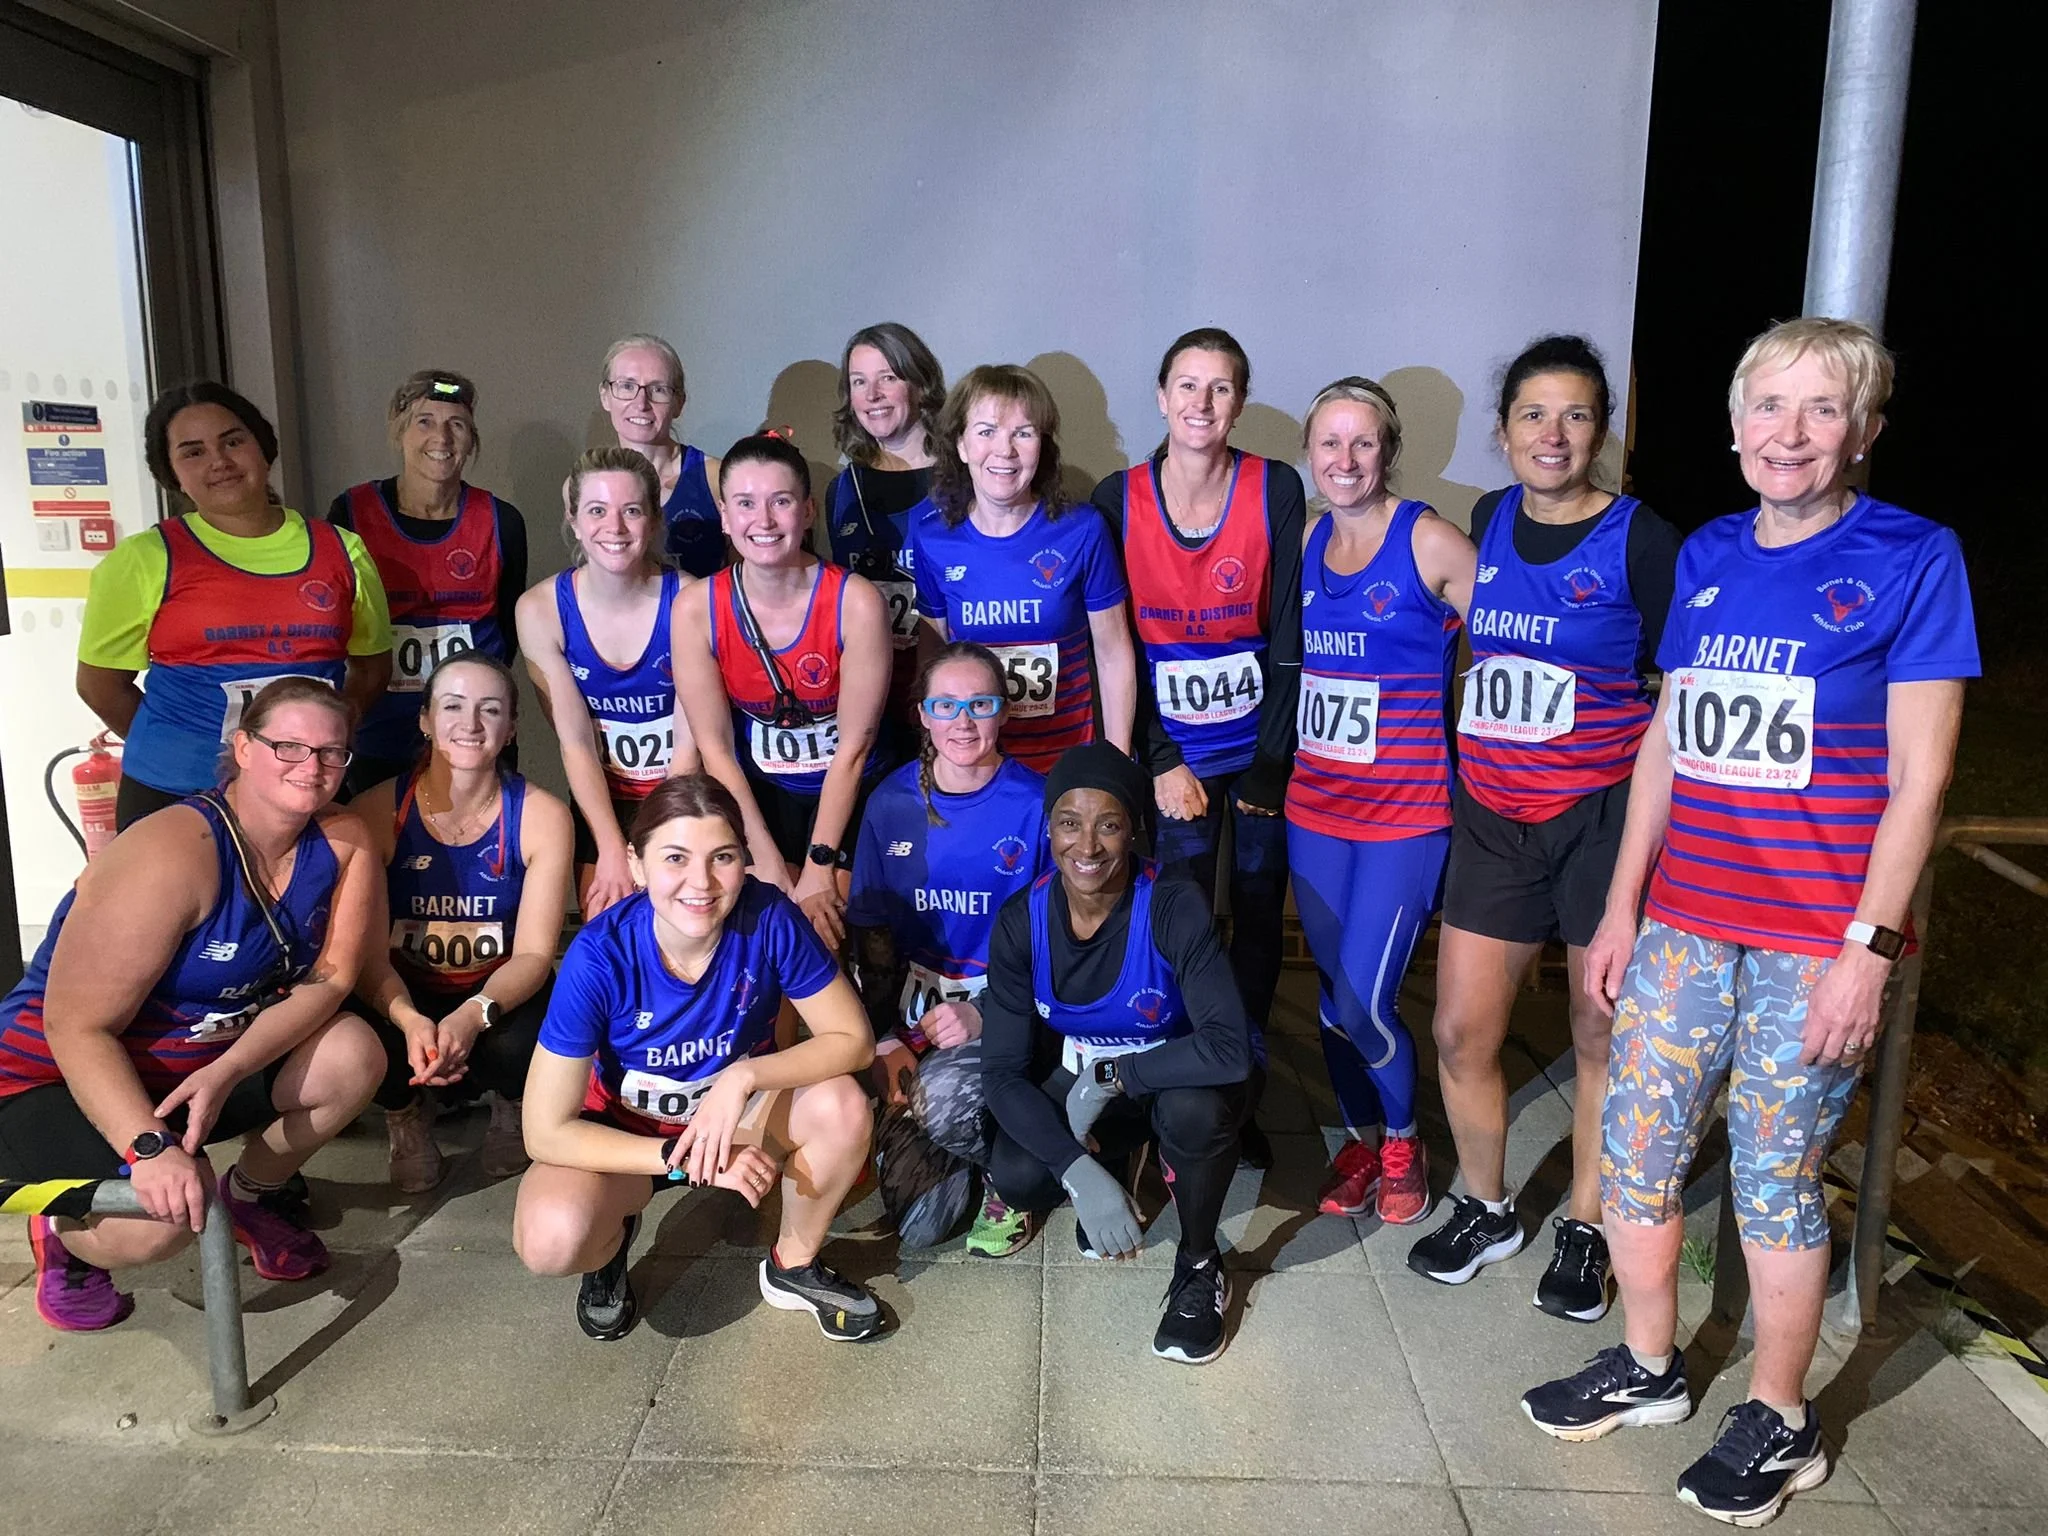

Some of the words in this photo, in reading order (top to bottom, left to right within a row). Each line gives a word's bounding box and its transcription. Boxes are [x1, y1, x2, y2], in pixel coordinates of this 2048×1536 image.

[1816, 577, 1843, 593] Barnet
[1846, 577, 1854, 585] &
[1856, 579, 1876, 602] District
[961, 599, 1043, 626] BARNET
[1139, 606, 1184, 622] BARNET
[1187, 612, 1196, 622] &
[1200, 602, 1253, 622] DISTRICT
[1811, 613, 1841, 633] Athletic
[1844, 621, 1865, 633] Club
[1185, 625, 1210, 636] A.C.
[1472, 607, 1560, 645] BARNET
[1303, 630, 1367, 657] BARNET
[1691, 633, 1807, 675] BARNET
[1007, 657, 1053, 702] 53
[1167, 666, 1259, 712] 1044
[586, 693, 667, 714] BARNET
[1475, 667, 1570, 724] 1017
[1302, 690, 1371, 745] 1075
[1469, 720, 1509, 733] CHINGFORD
[1510, 725, 1539, 736] LEAGUE
[1678, 688, 1806, 765] 1026
[1719, 764, 1762, 779] LEAGUE
[1765, 768, 1800, 780] 23/24
[411, 895, 497, 917] BARNET
[914, 888, 992, 915] BARNET
